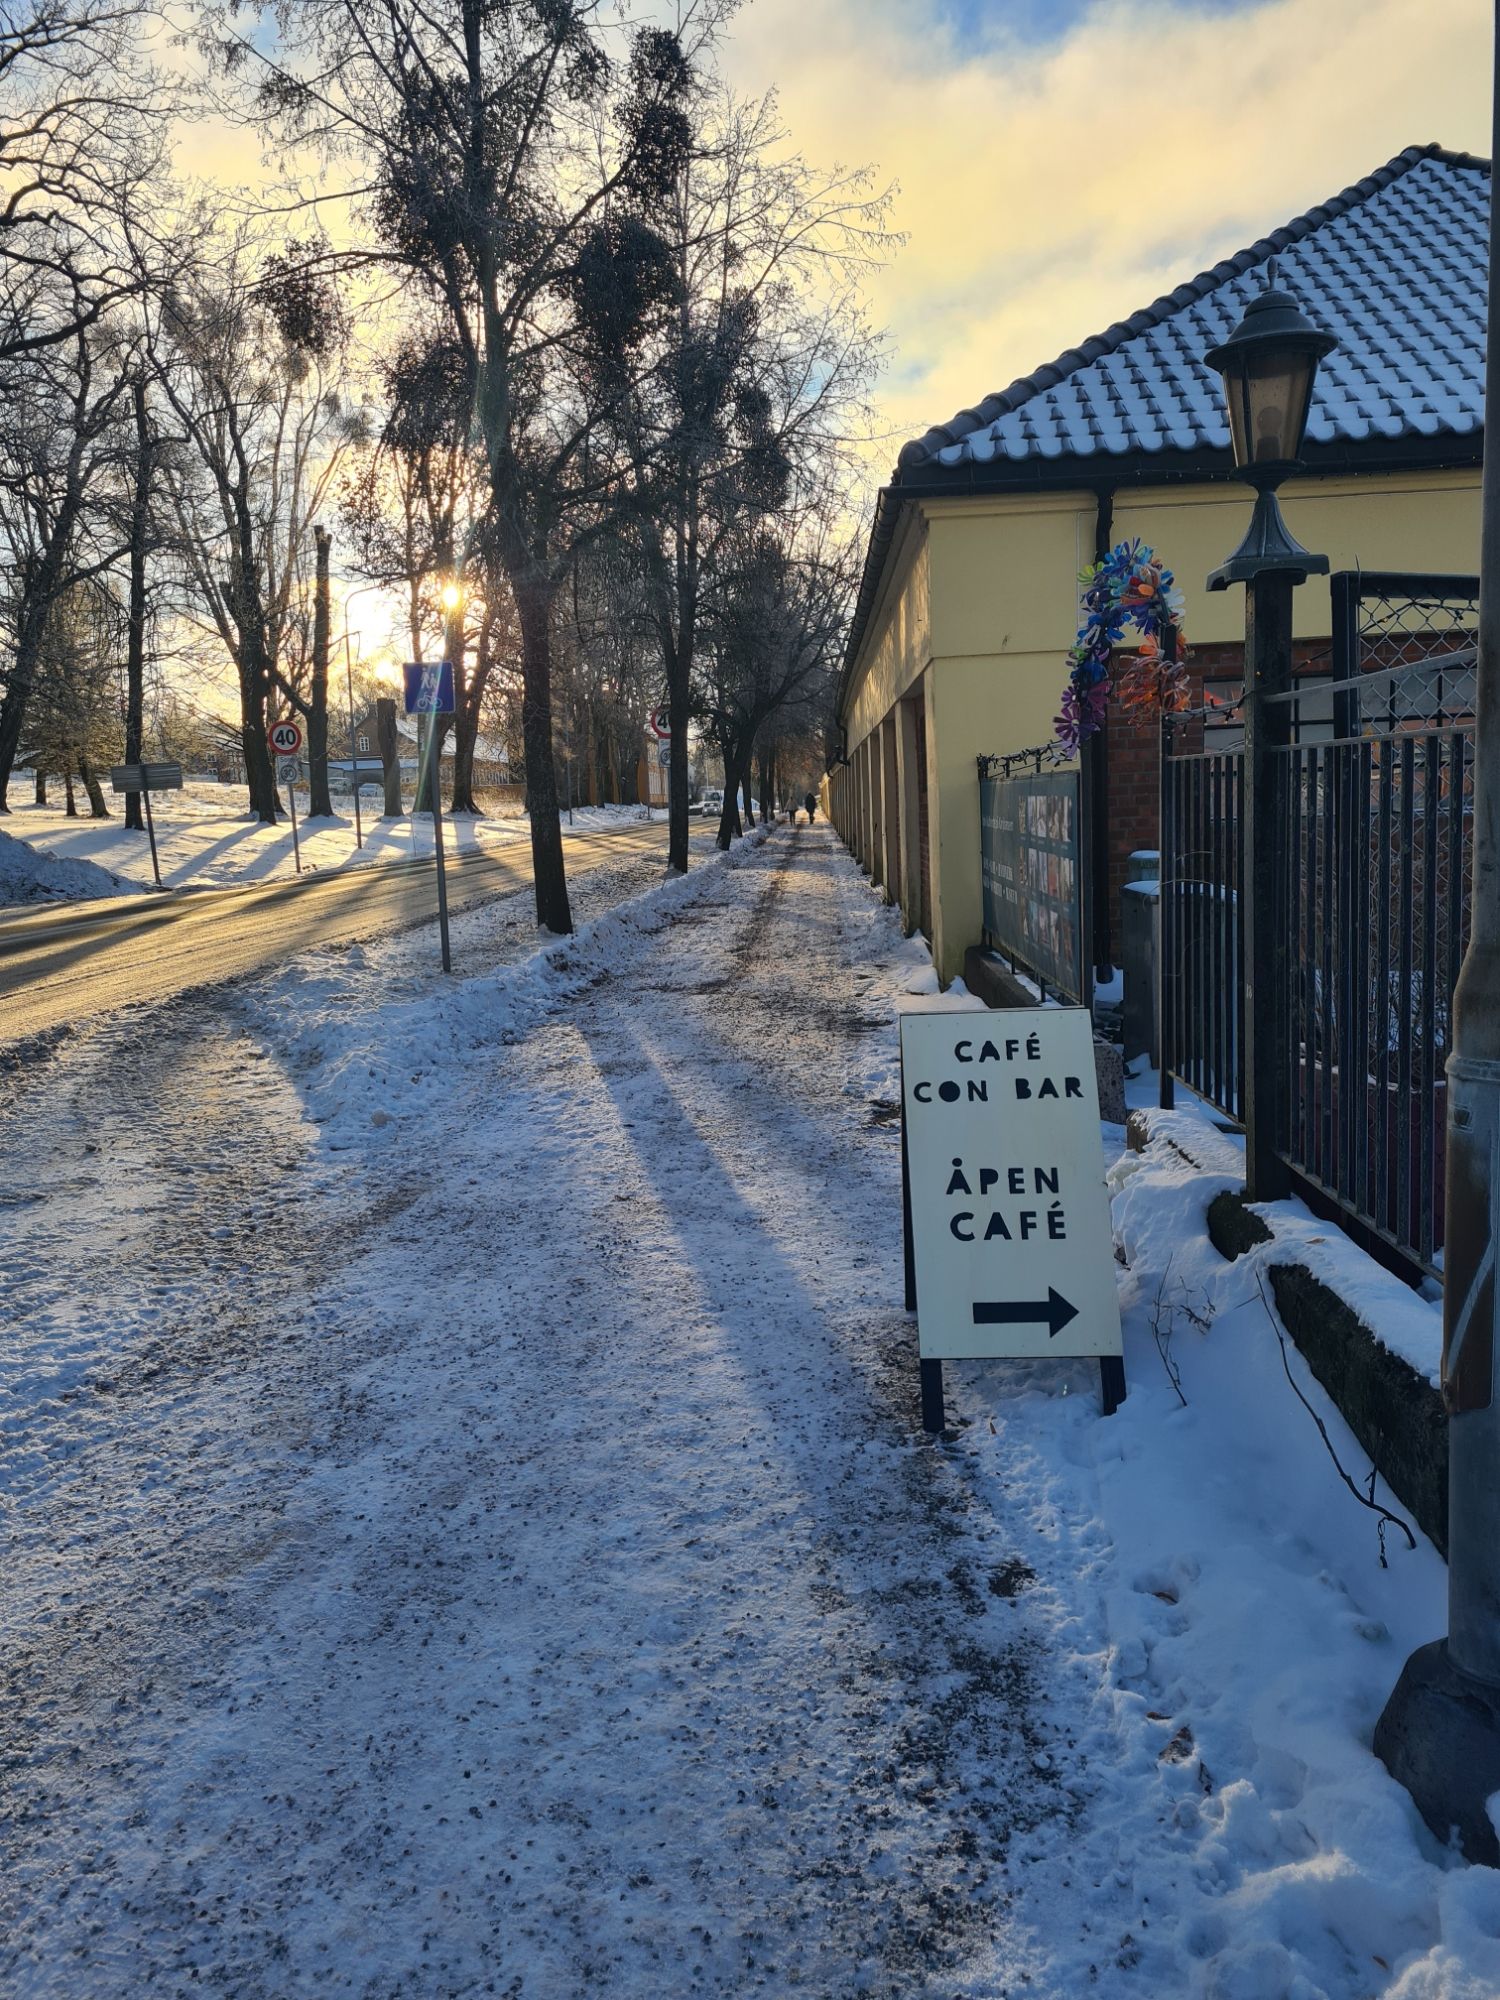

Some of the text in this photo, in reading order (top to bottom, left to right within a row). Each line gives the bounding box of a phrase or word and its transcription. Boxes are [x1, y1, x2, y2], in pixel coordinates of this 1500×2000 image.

[657, 711, 671, 728] 4
[275, 729, 296, 745] 40
[955, 1032, 1041, 1062] CAFÉ
[913, 1077, 1084, 1103] CON BAR
[946, 1157, 1059, 1195] ÅPEN
[950, 1200, 1066, 1241] CAFÉ
